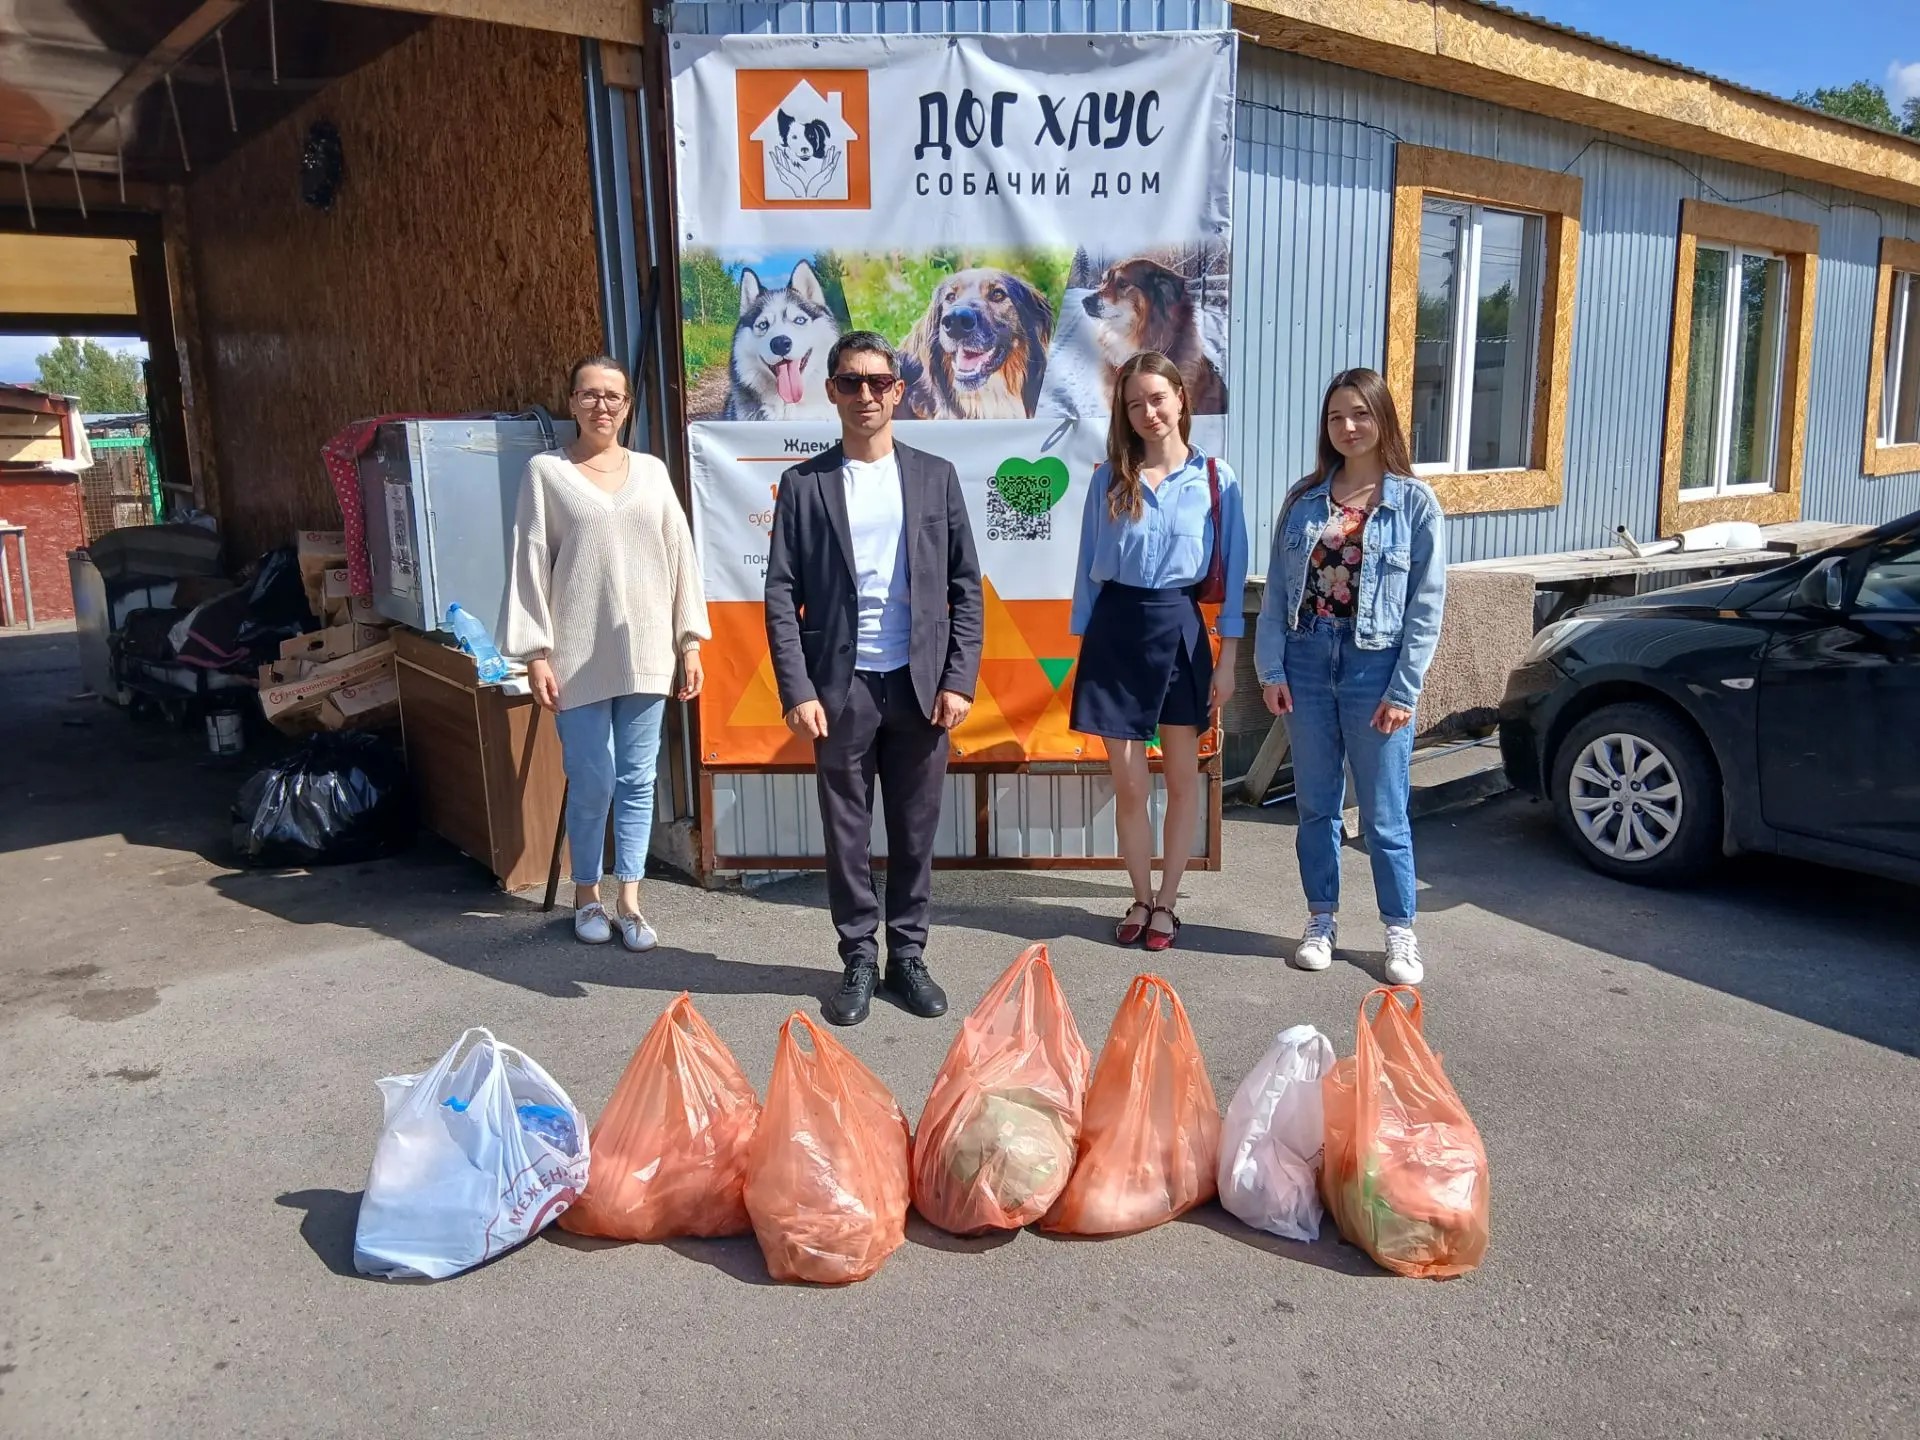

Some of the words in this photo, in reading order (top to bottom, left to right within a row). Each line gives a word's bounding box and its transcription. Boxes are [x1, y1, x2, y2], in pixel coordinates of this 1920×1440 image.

[914, 88, 1018, 160] ДОГ
[1034, 90, 1165, 151] ХАУС
[916, 167, 1070, 195] СОБАЧИЙ
[1091, 171, 1160, 198] ДОМ
[783, 438, 830, 453] Ждем
